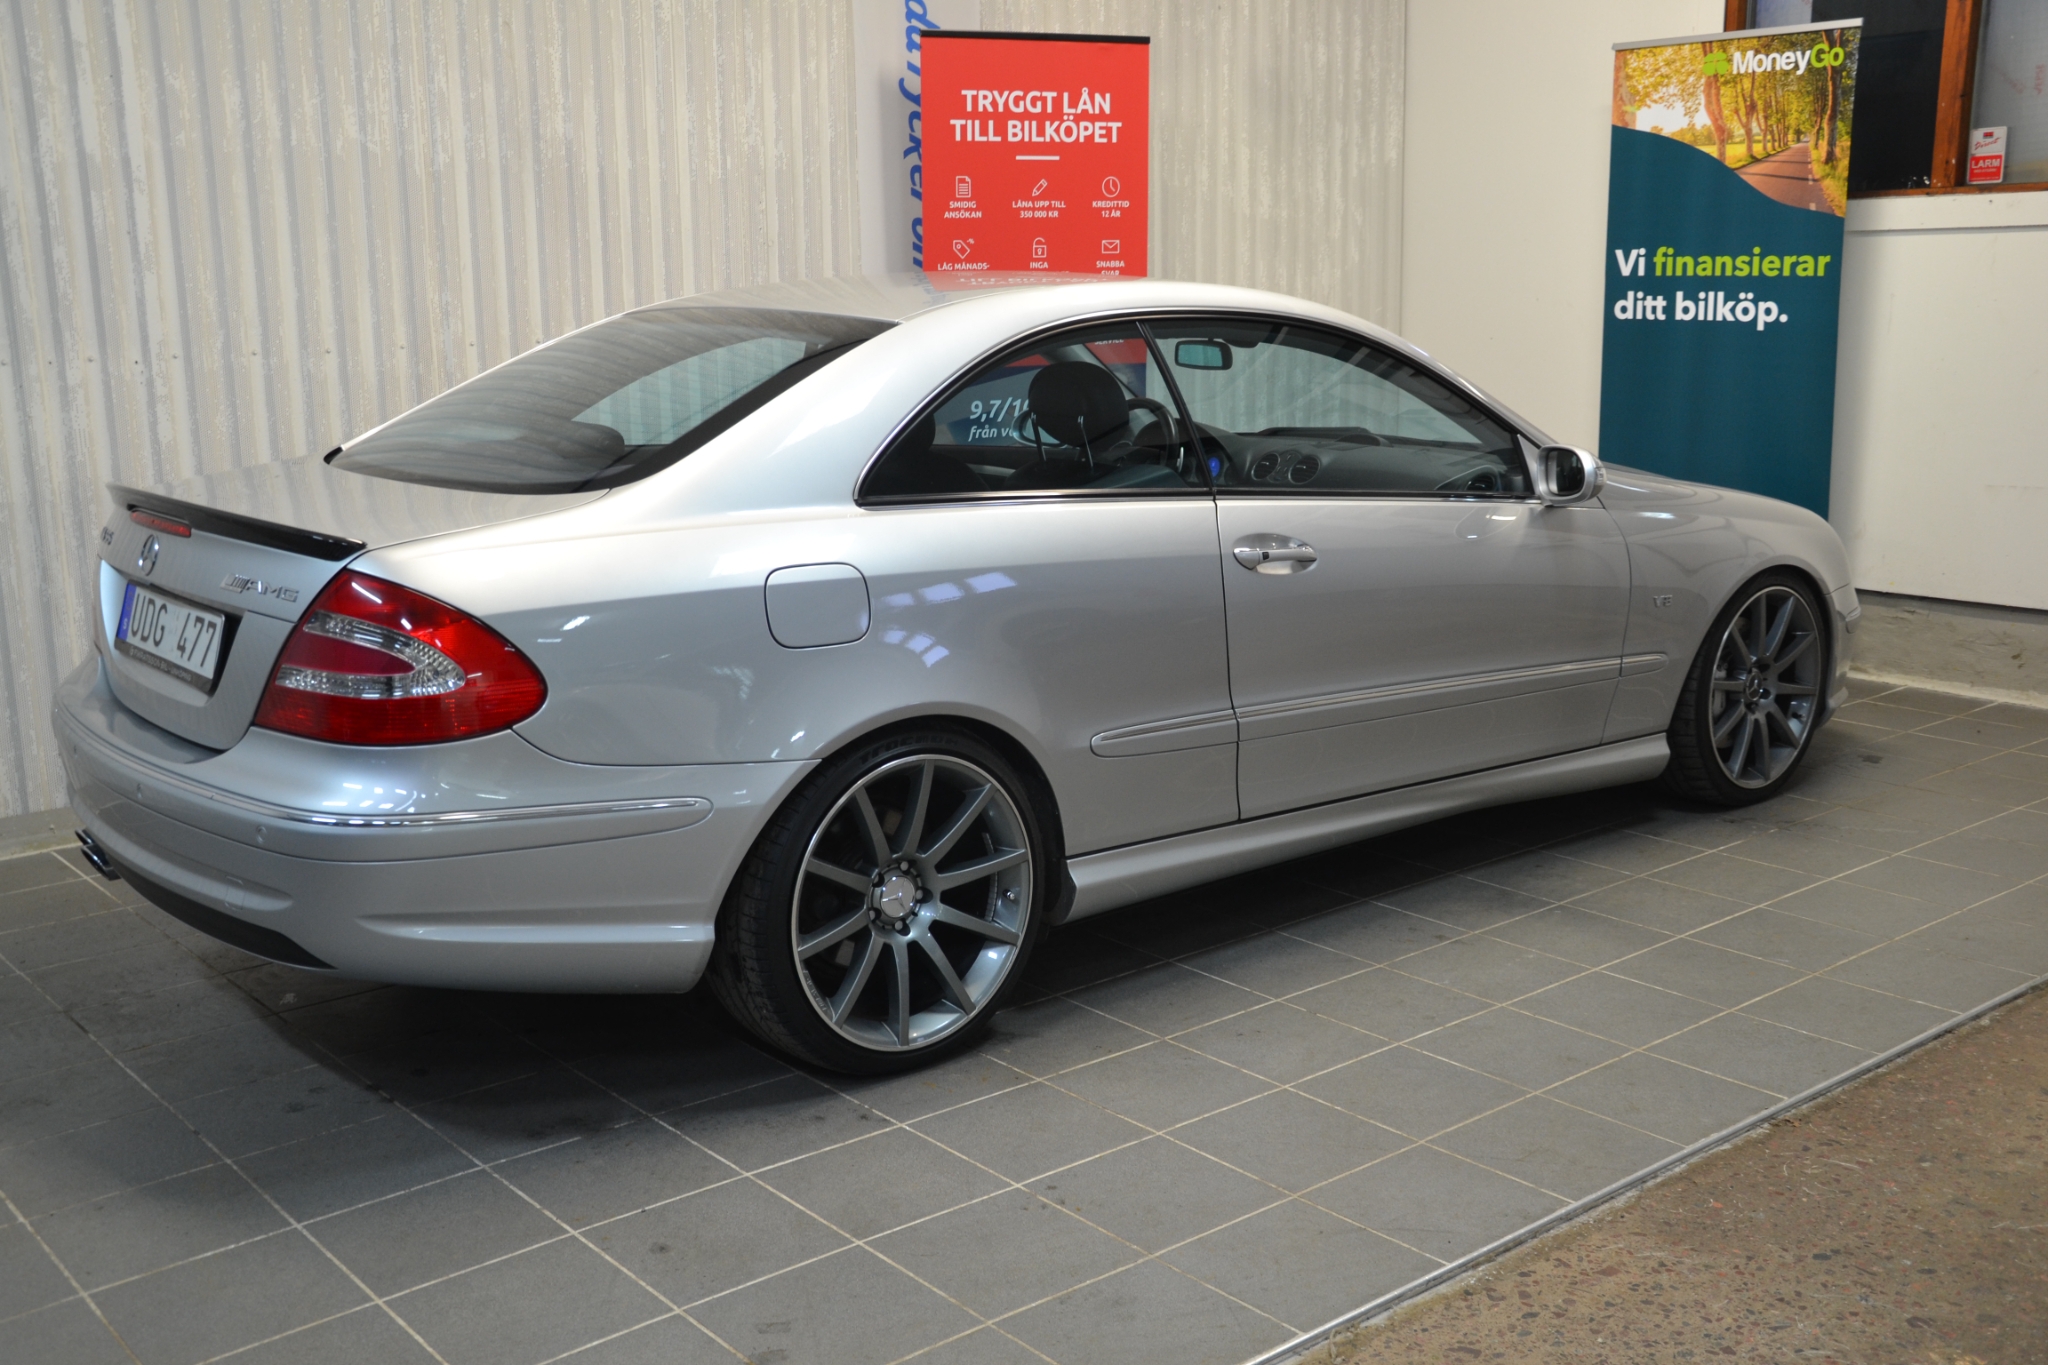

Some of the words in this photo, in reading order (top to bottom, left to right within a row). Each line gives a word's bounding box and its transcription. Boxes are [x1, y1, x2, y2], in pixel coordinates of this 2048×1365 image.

[1732, 43, 1844, 76] MoneyGo
[961, 90, 1056, 113] TRYGGT
[1063, 87, 1111, 115] LÅN
[950, 119, 1001, 141] TILL
[1008, 115, 1122, 143] BILKÖPET
[1972, 159, 2000, 168] LARM
[949, 201, 976, 209] SMIDIG
[1012, 199, 1032, 208] LÅNA
[1033, 200, 1049, 208] UPP
[1051, 200, 1066, 208] TILL
[1092, 200, 1129, 208] KREDITTID
[944, 209, 982, 219] ANSÖKAN
[1048, 210, 1059, 218] KR
[1110, 209, 1121, 218] ÅR
[1030, 261, 1048, 269] INGA
[1096, 260, 1125, 268] SNABBA
[1614, 248, 1646, 277] Vi
[1654, 245, 1831, 277] finansierar
[938, 262, 953, 271] LÅG
[954, 262, 990, 271] MÅNADS-
[1613, 291, 1667, 321] ditt
[1675, 290, 1789, 331] bilköp.
[968, 424, 998, 442] från
[246, 579, 300, 603] AMG
[130, 592, 168, 647] UDG
[177, 612, 217, 667] 477
